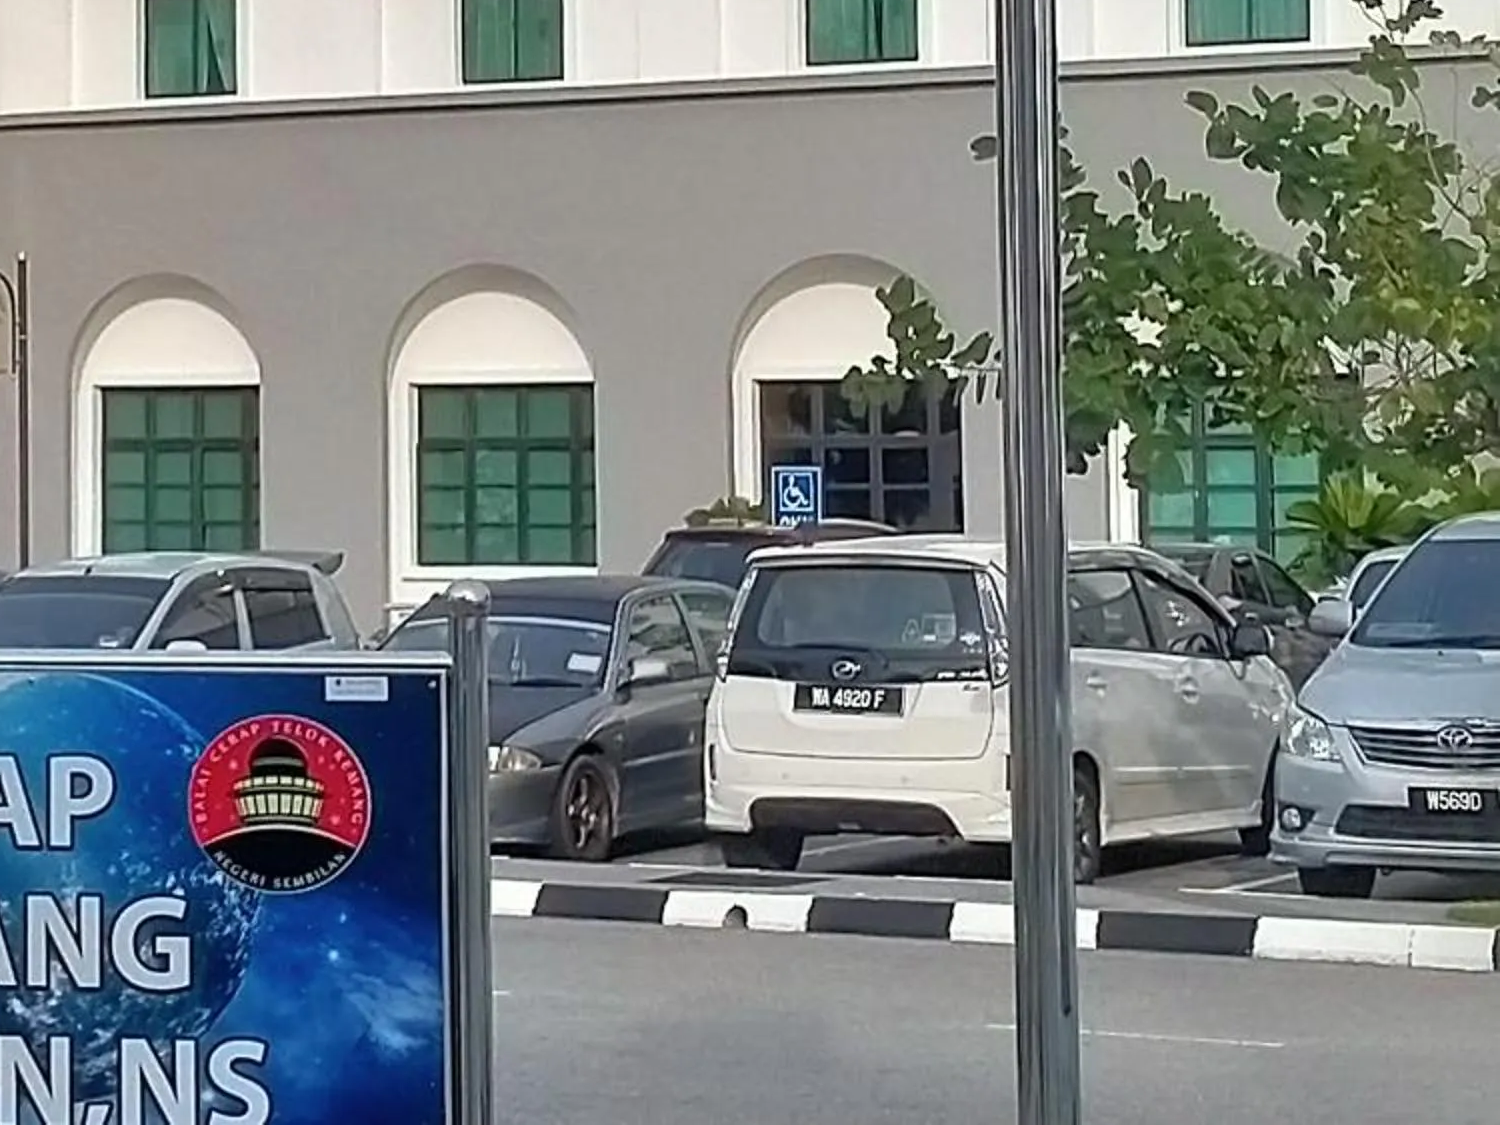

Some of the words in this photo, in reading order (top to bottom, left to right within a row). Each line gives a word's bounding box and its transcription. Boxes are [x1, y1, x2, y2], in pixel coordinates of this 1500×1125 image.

[811, 686, 830, 707] WA
[833, 687, 872, 707] 4920
[873, 690, 885, 709] F
[193, 768, 212, 824] BALAI
[209, 723, 260, 763] CERAP
[271, 721, 330, 748] TELOK
[333, 750, 364, 825] KEMANG
[1426, 790, 1483, 812] W569D
[213, 850, 266, 887] NEGERI
[272, 851, 347, 888] SEMBILAN
